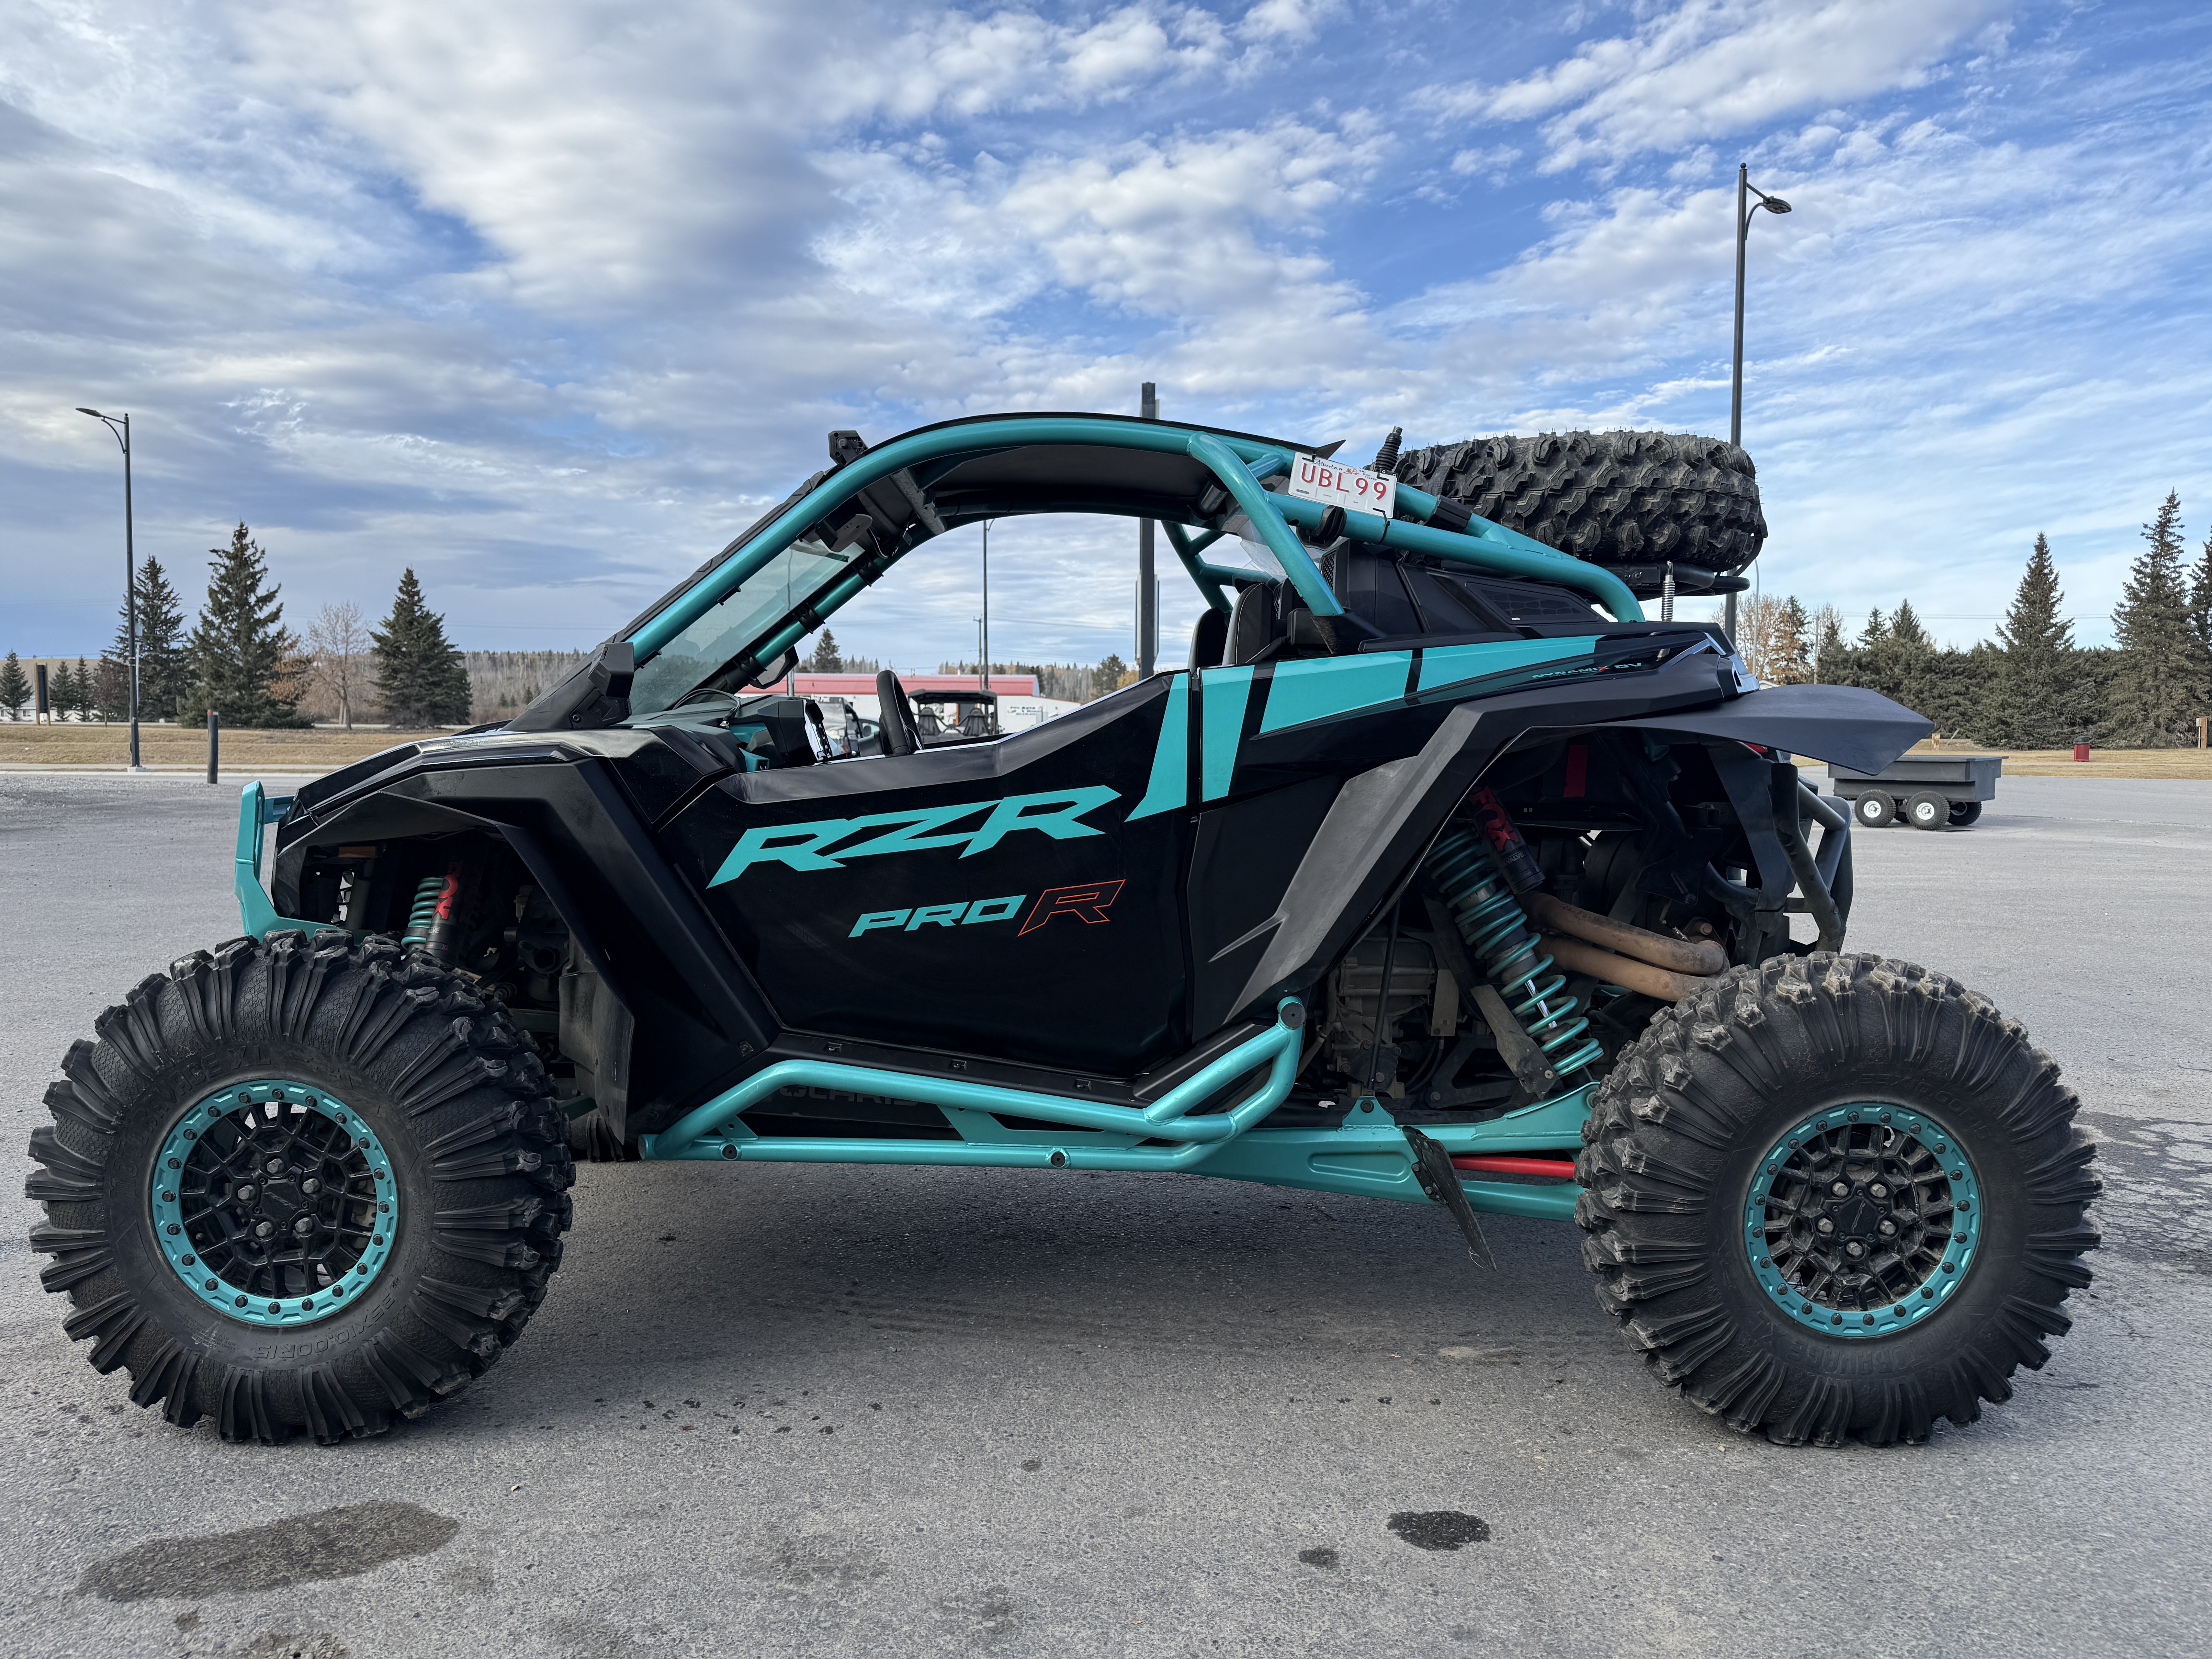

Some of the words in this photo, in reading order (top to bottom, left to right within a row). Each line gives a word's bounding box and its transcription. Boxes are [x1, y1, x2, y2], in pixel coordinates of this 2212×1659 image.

[1301, 463, 1386, 500] UBL99
[1532, 665, 1608, 678] DYNAMIX
[706, 785, 1122, 889] RZR
[1468, 786, 1520, 852] FOX
[1505, 851, 1525, 864] VALVE
[848, 895, 1027, 937] PRO
[1018, 879, 1126, 936] R
